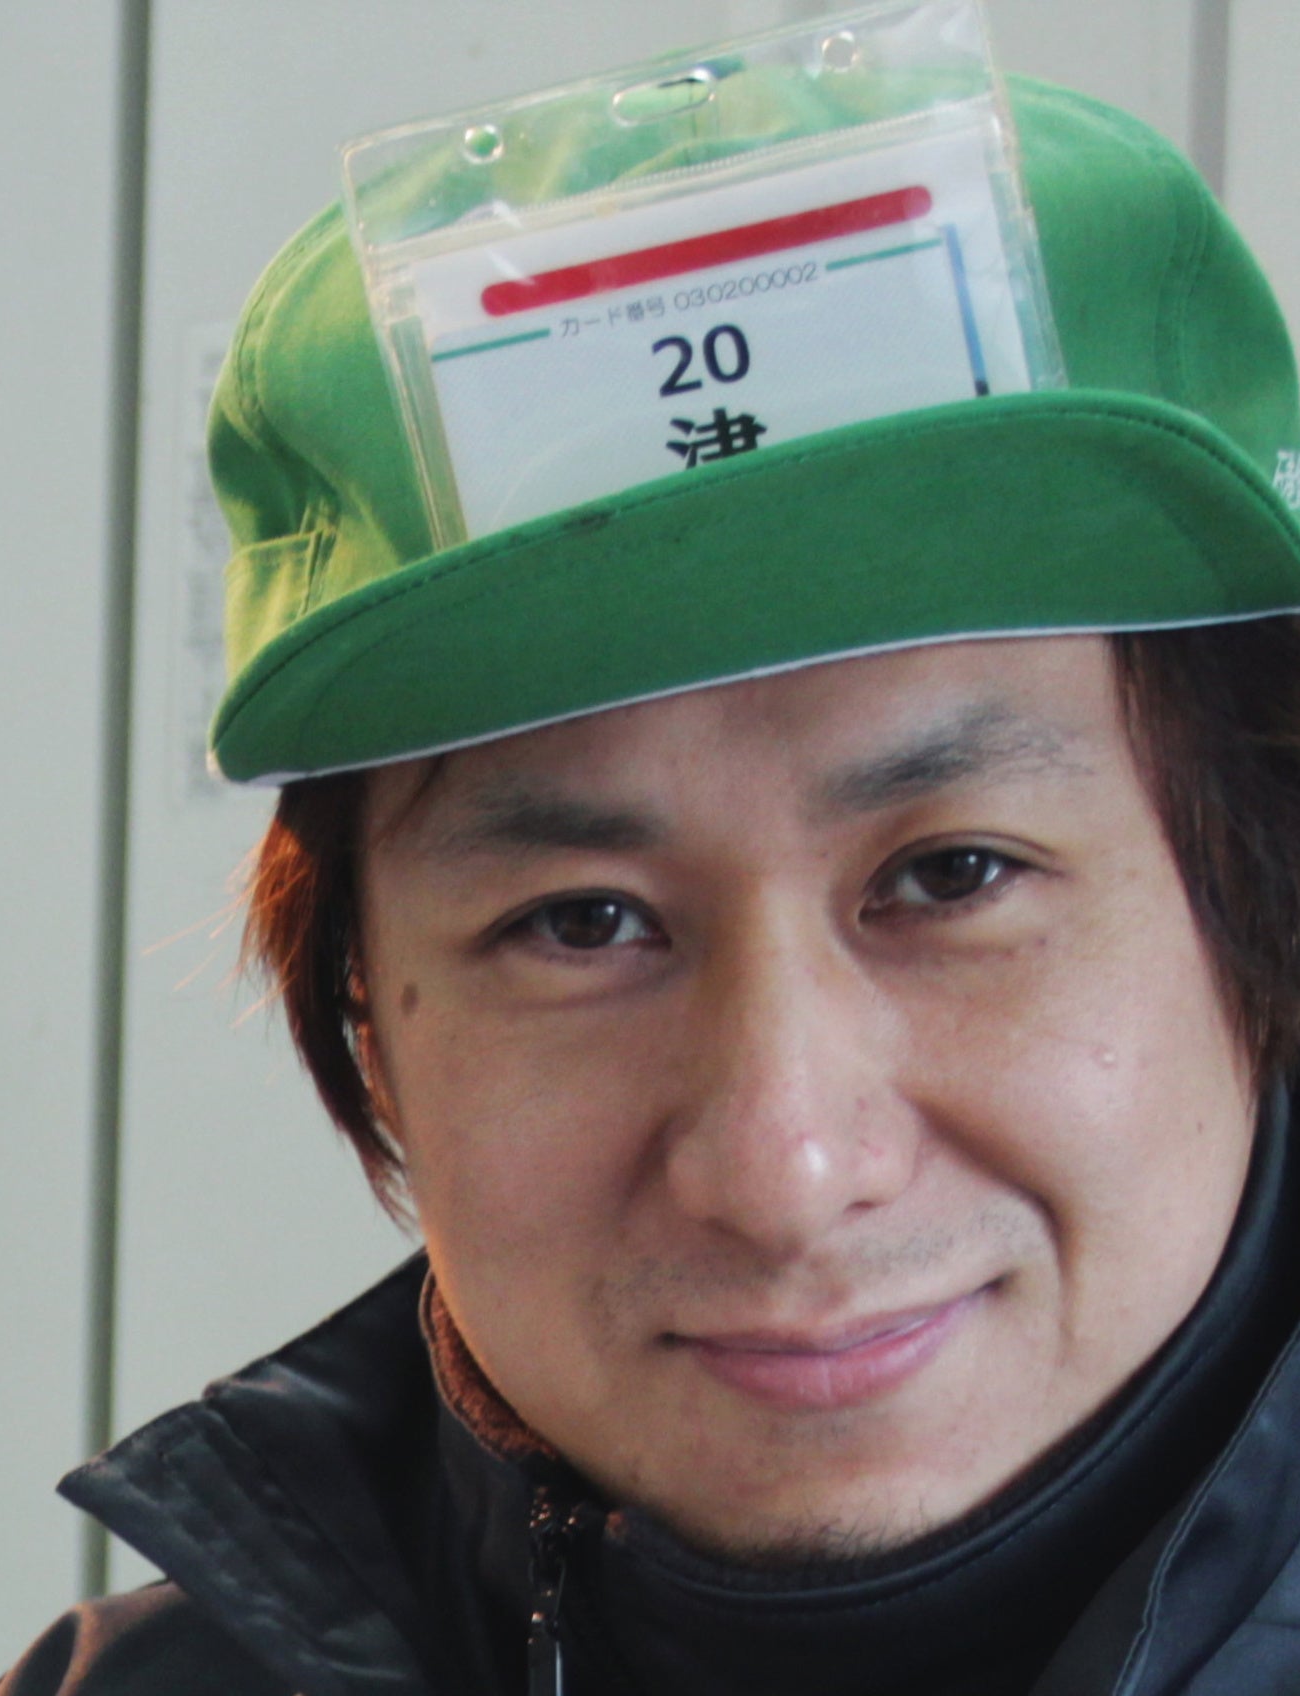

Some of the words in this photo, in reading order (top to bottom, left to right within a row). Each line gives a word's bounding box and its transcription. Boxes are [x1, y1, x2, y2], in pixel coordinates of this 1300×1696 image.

[561, 297, 665, 337] カード番号
[673, 262, 817, 310] 030200002
[652, 323, 750, 398] 20
